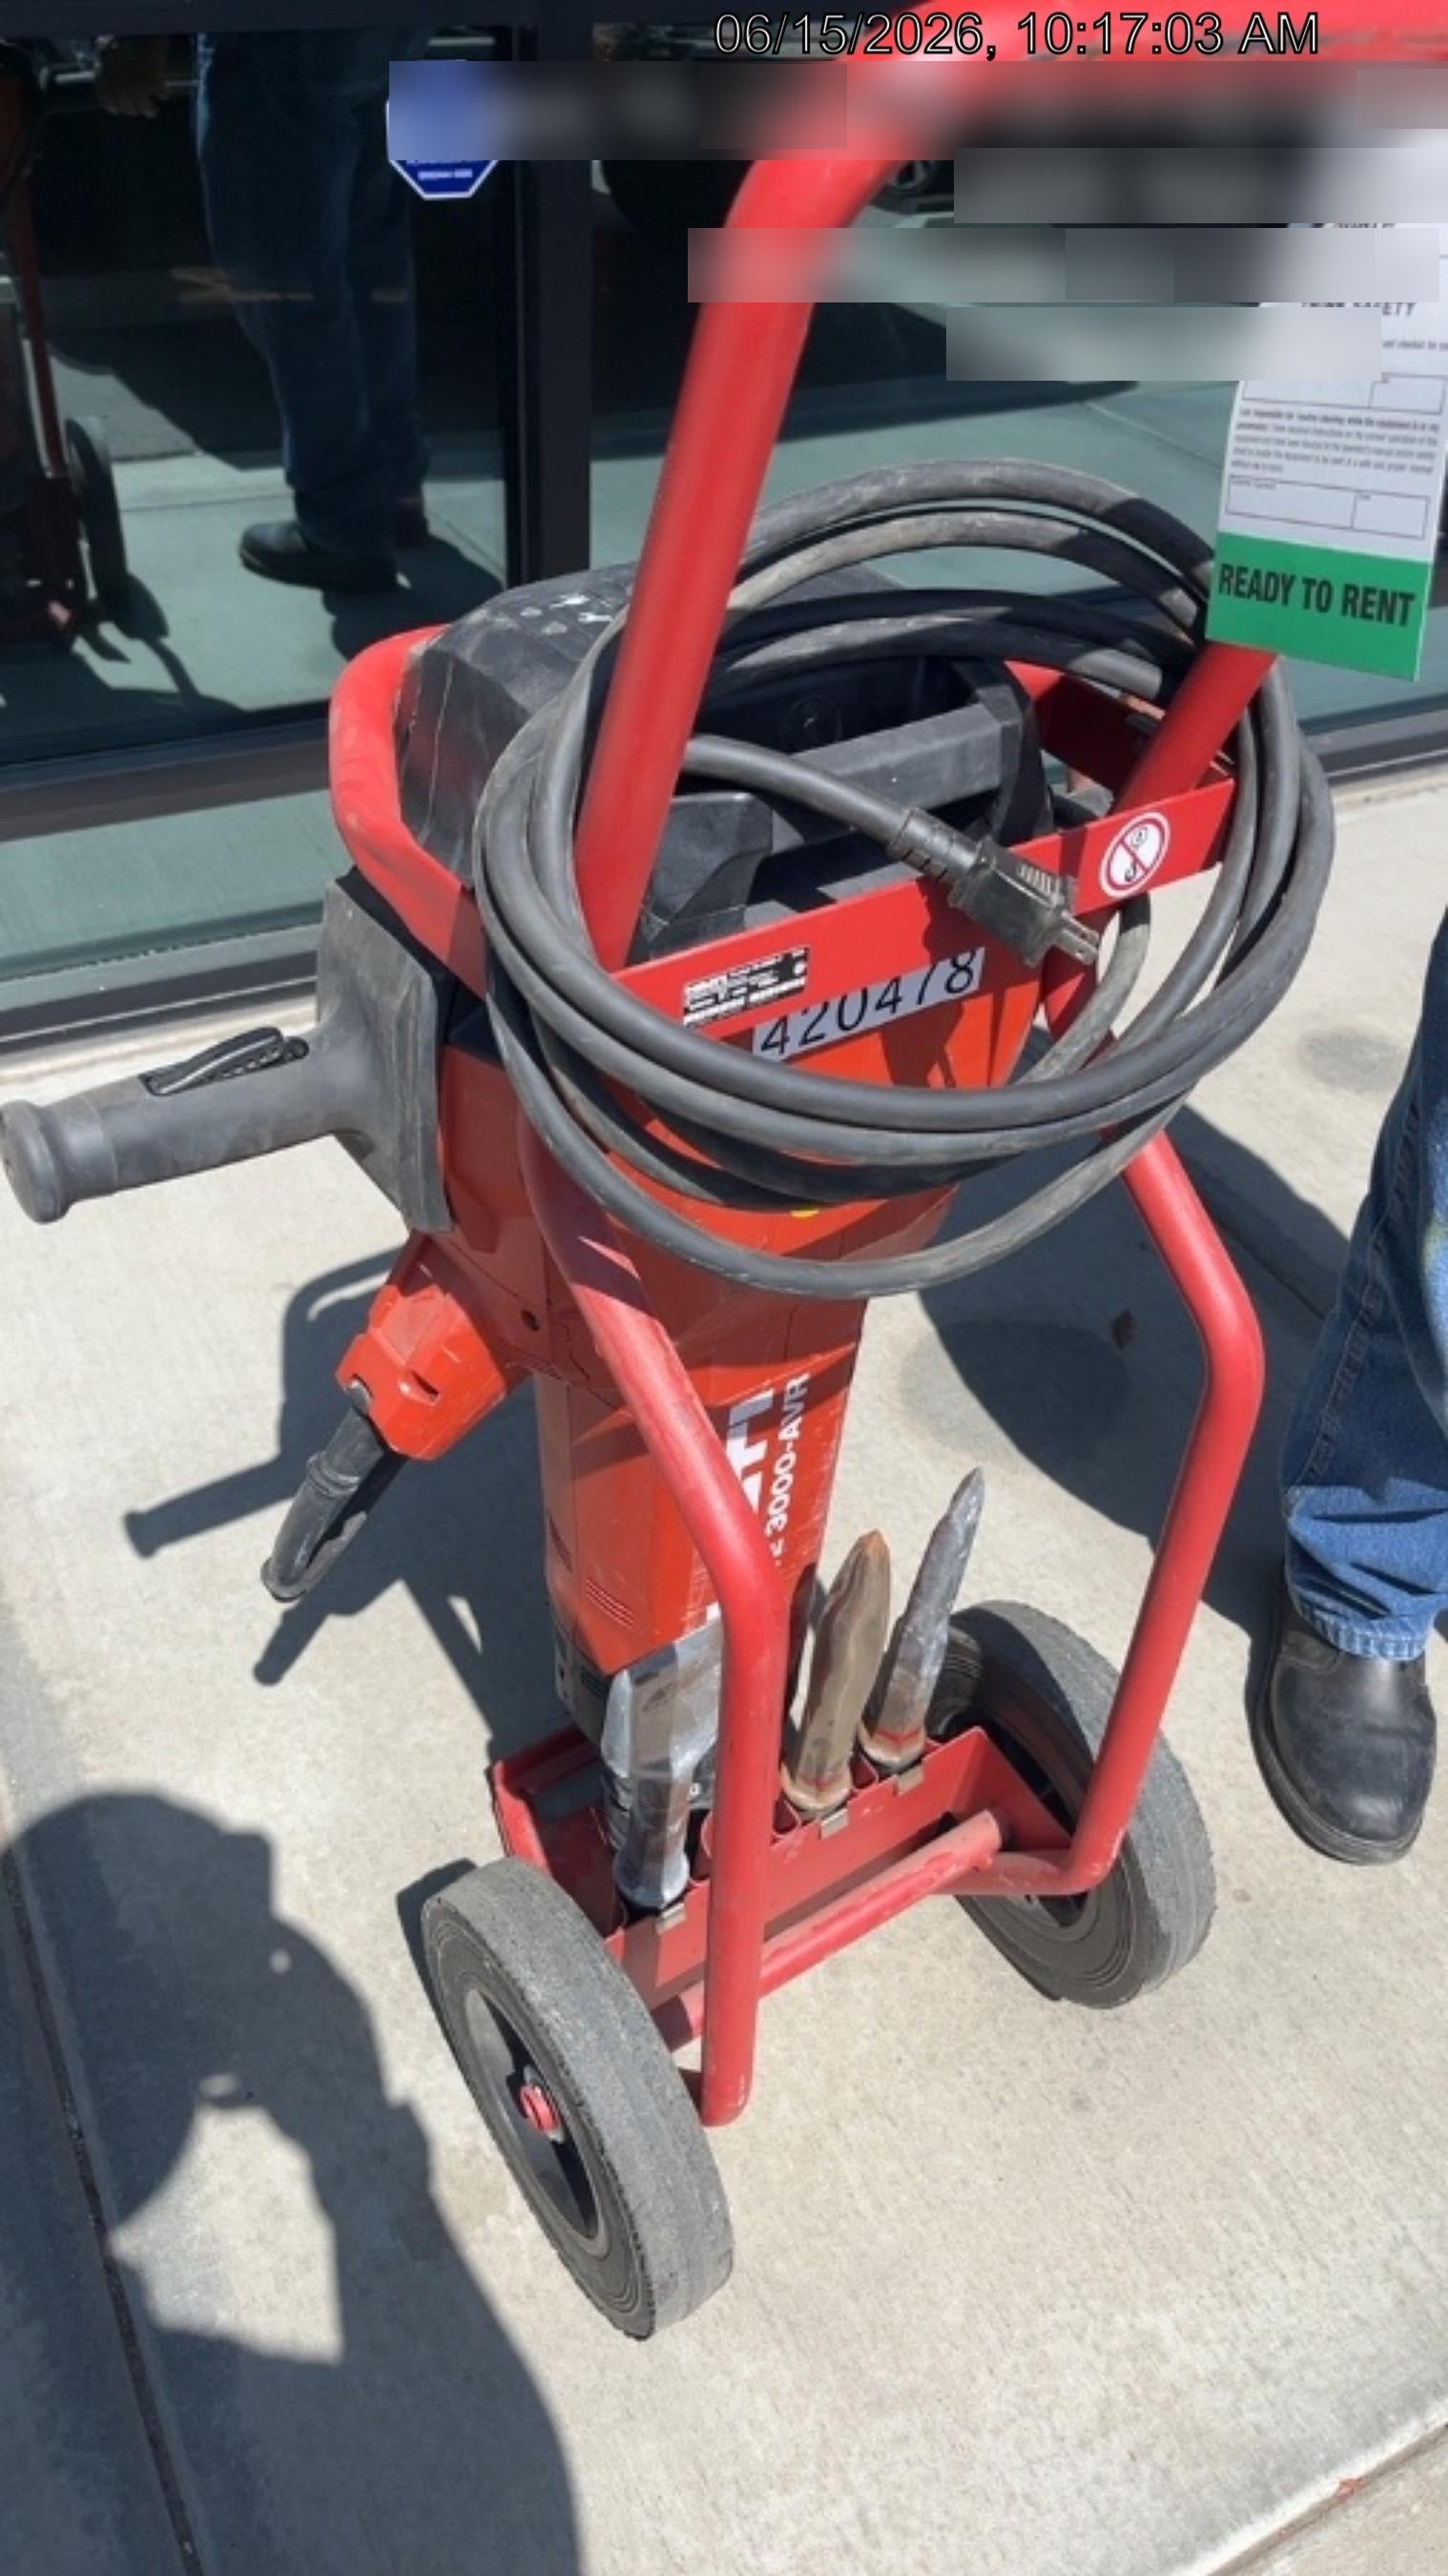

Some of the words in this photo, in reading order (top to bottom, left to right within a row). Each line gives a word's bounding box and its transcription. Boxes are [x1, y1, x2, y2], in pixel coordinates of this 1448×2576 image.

[1217, 563, 1297, 608] READY
[1301, 577, 1334, 613] TO
[1340, 583, 1417, 628] RENT
[760, 949, 977, 1056] 420478
[766, 1373, 810, 1539] 3000-AVR
